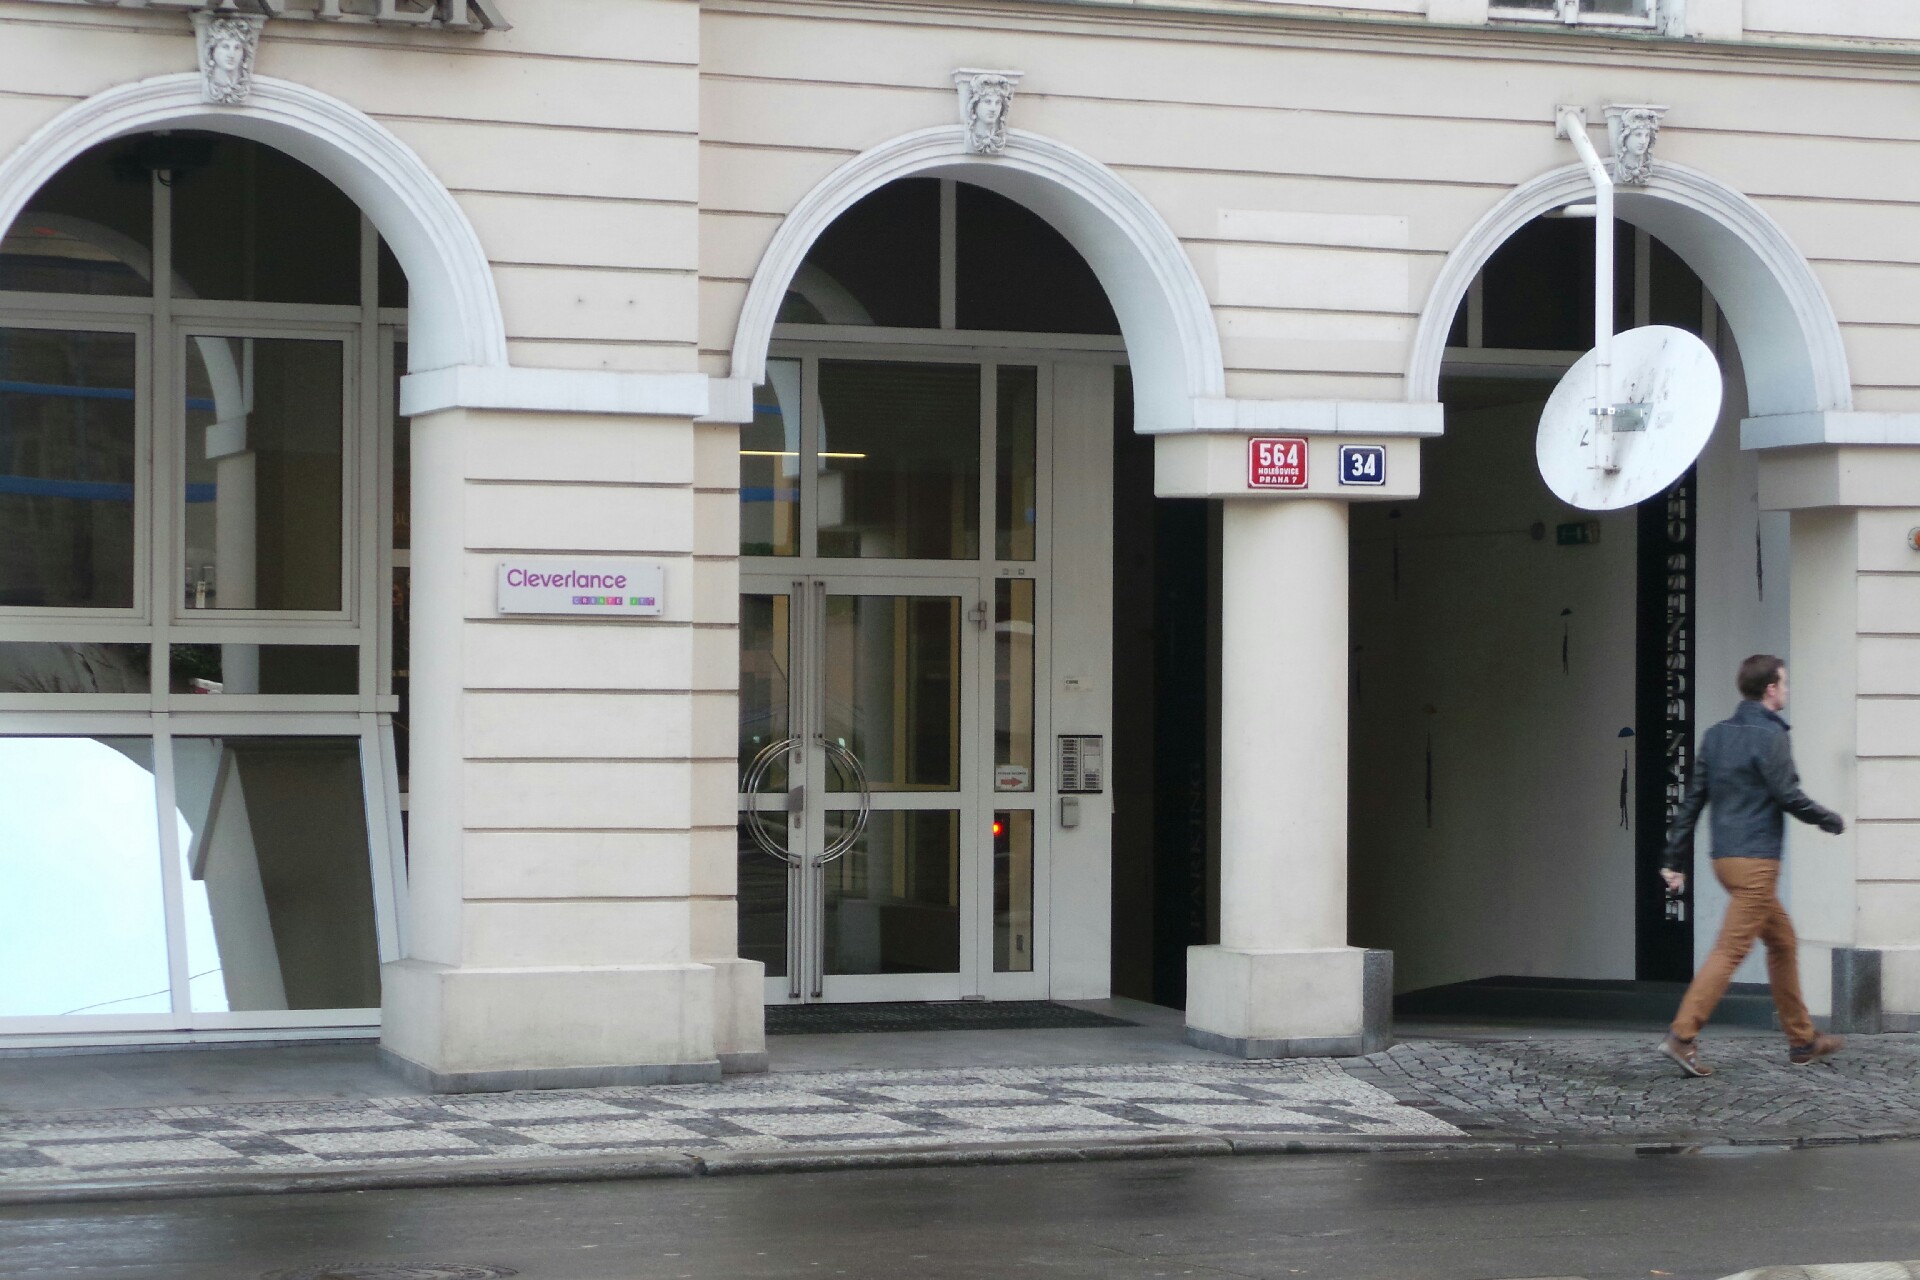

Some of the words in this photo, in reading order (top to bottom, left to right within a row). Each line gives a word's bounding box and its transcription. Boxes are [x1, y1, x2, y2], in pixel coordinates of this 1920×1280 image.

[1259, 443, 1298, 466] 564
[1351, 453, 1376, 476] 34
[1259, 476, 1289, 484] PRAHA
[507, 568, 627, 588] Cleverlance
[1665, 553, 1686, 721] BUSINESS
